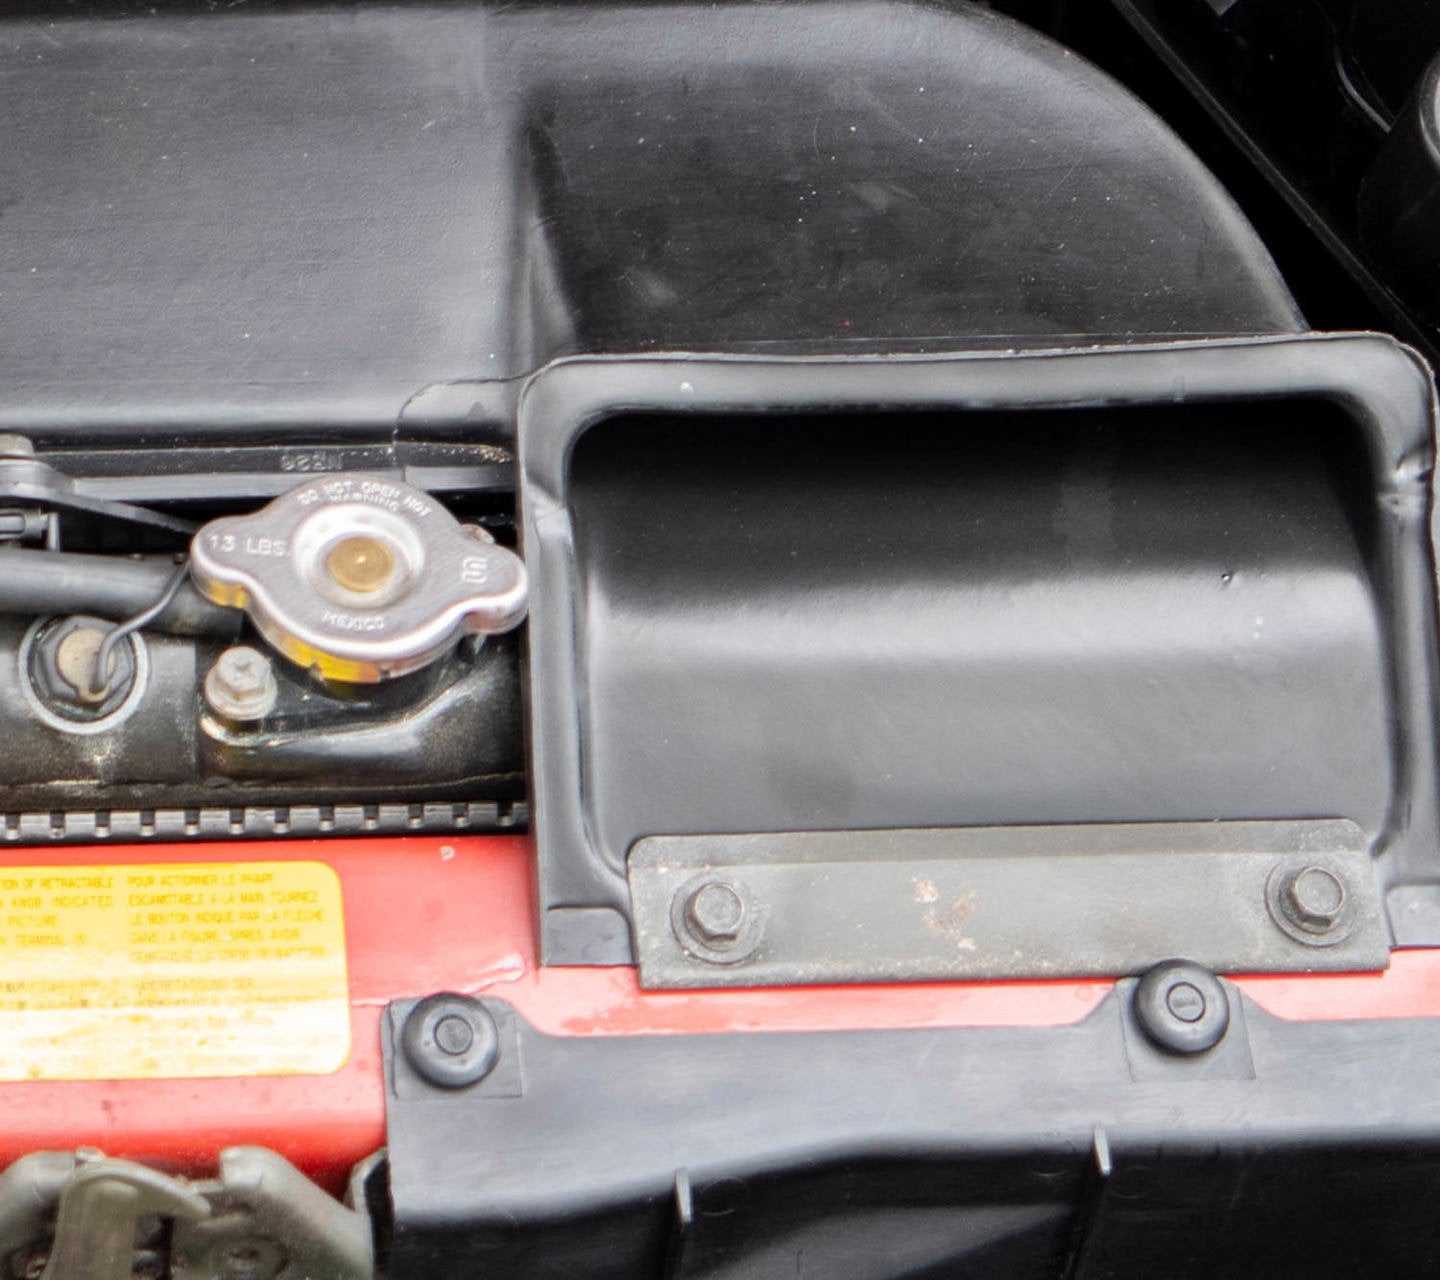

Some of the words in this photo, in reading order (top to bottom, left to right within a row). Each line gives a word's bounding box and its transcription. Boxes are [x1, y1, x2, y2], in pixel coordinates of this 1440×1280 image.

[296, 487, 319, 506] DO
[323, 479, 353, 496] NOT
[360, 480, 401, 501] OPEN
[329, 493, 401, 512] WARNING
[209, 534, 236, 553] 13
[320, 610, 385, 631] MEXICO
[40, 876, 115, 889] RETRACTABLE
